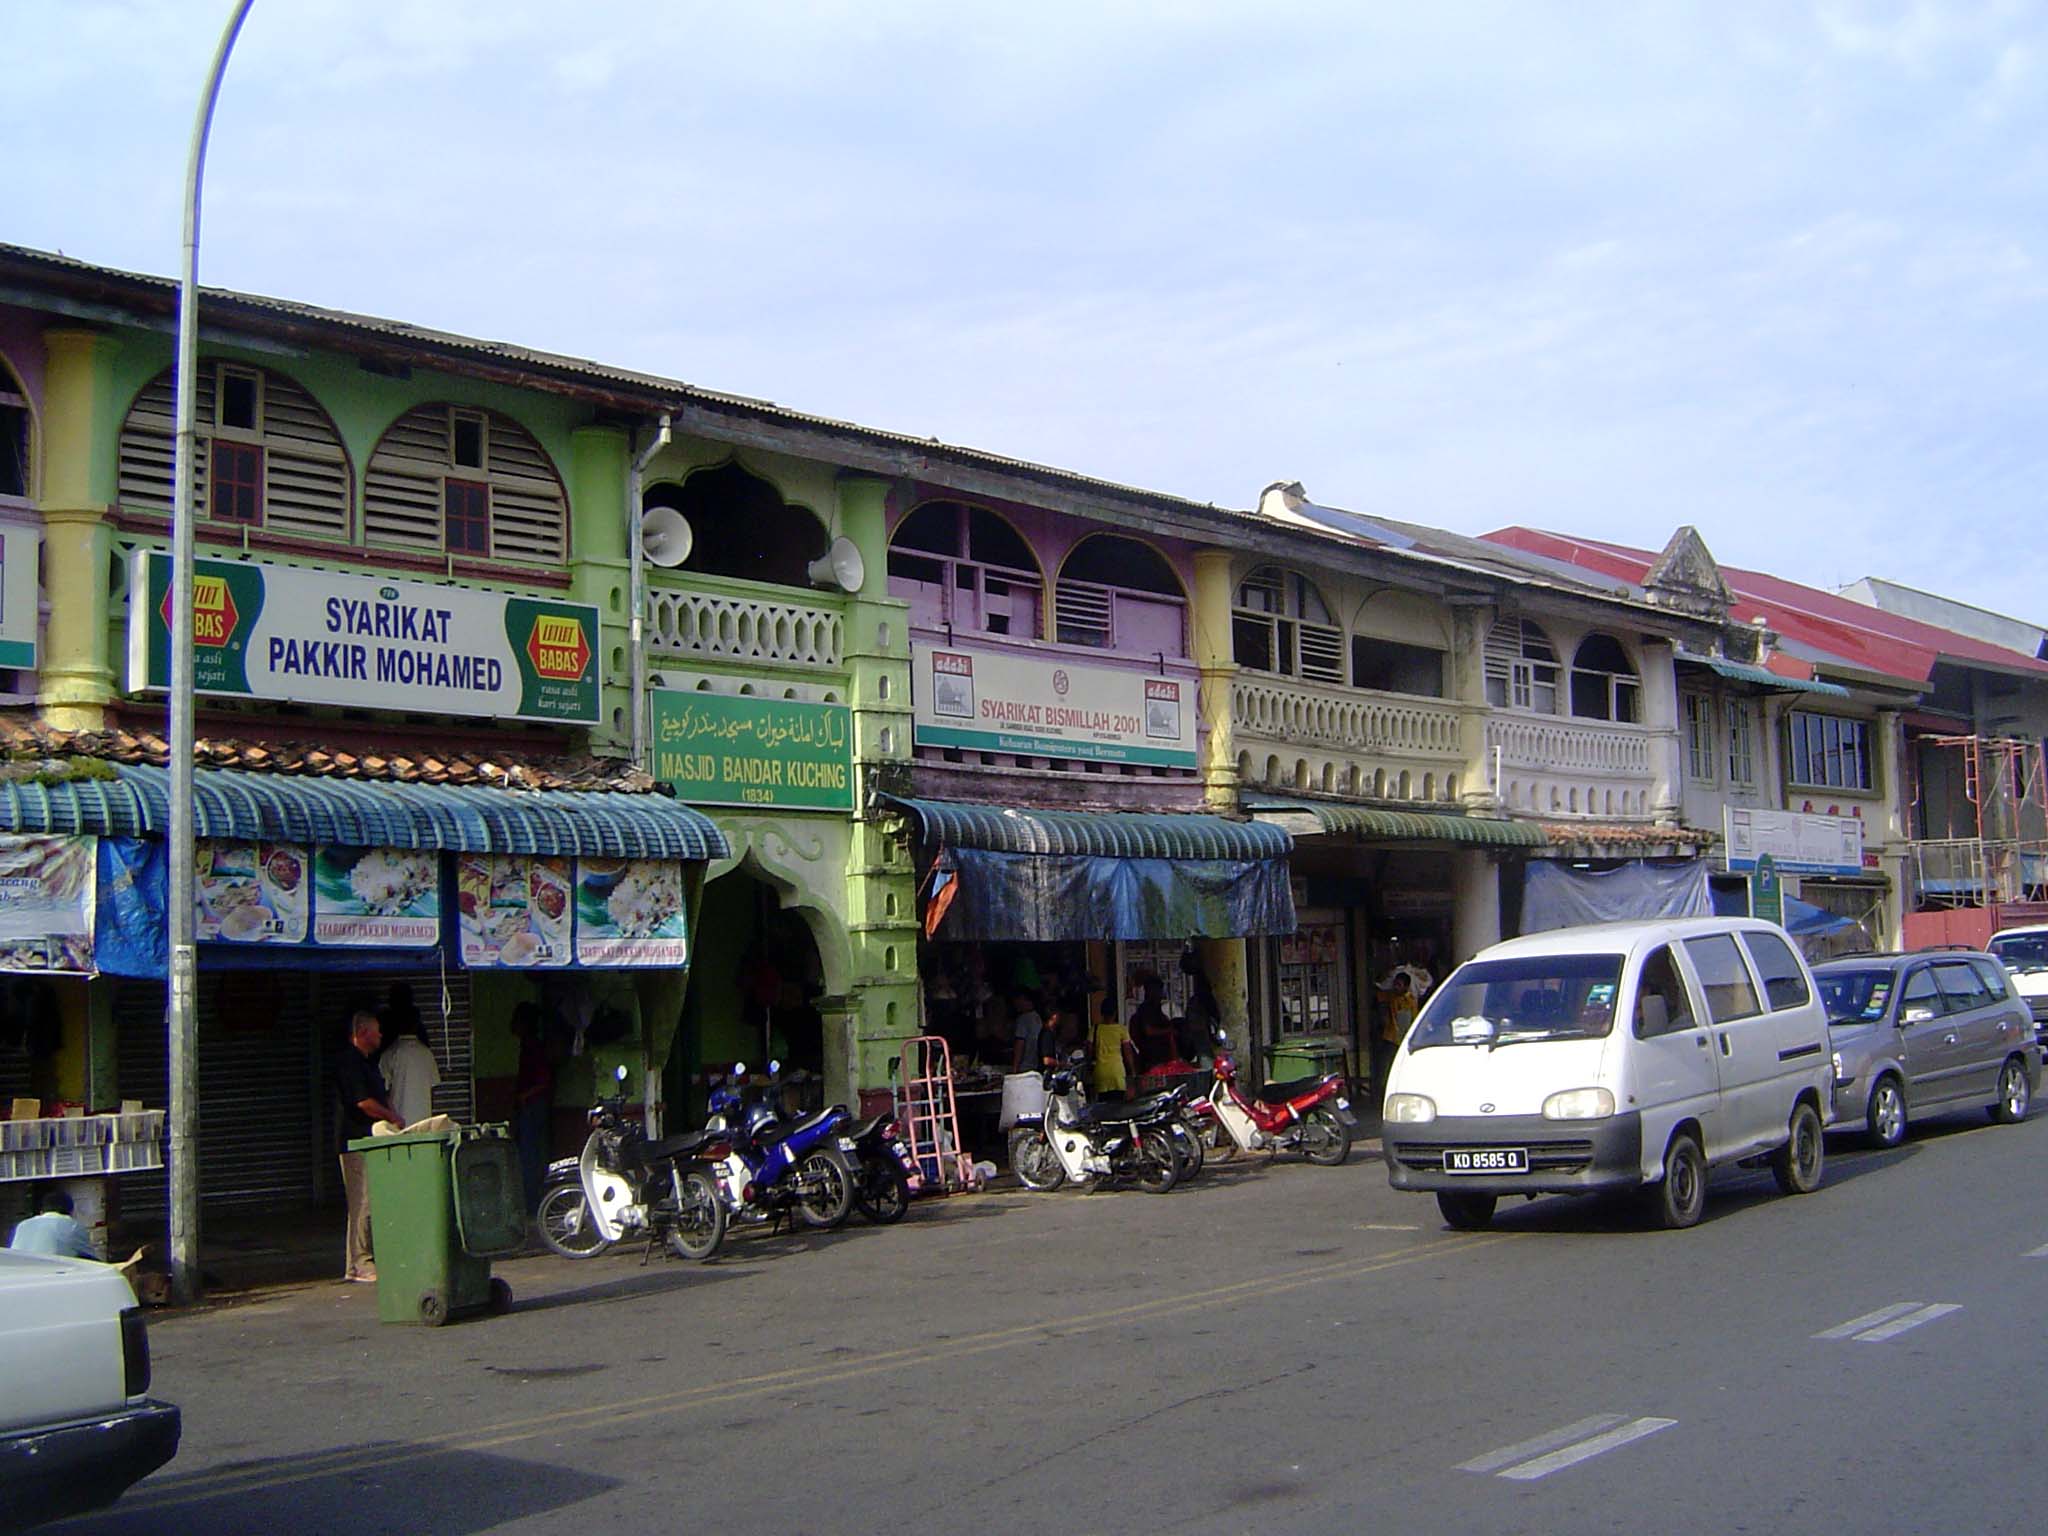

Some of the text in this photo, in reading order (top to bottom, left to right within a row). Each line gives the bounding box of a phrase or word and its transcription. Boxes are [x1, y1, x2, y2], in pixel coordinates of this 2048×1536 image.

[195, 612, 223, 638] BA'S
[326, 597, 452, 644] SYARIKAT
[269, 637, 502, 692] PAKKIR MOHAMED
[936, 657, 969, 674] adabi
[1148, 684, 1176, 700] adabi
[981, 699, 1042, 724] SYARIKAT
[1045, 707, 1110, 732] BISMILLAH
[1114, 715, 1141, 734] 2001
[661, 752, 846, 790] MASJID BANDAR KUCHING
[742, 789, 774, 804] (1834)
[1762, 870, 1769, 887] P
[1454, 1152, 1517, 1168] KD 8585 Q
